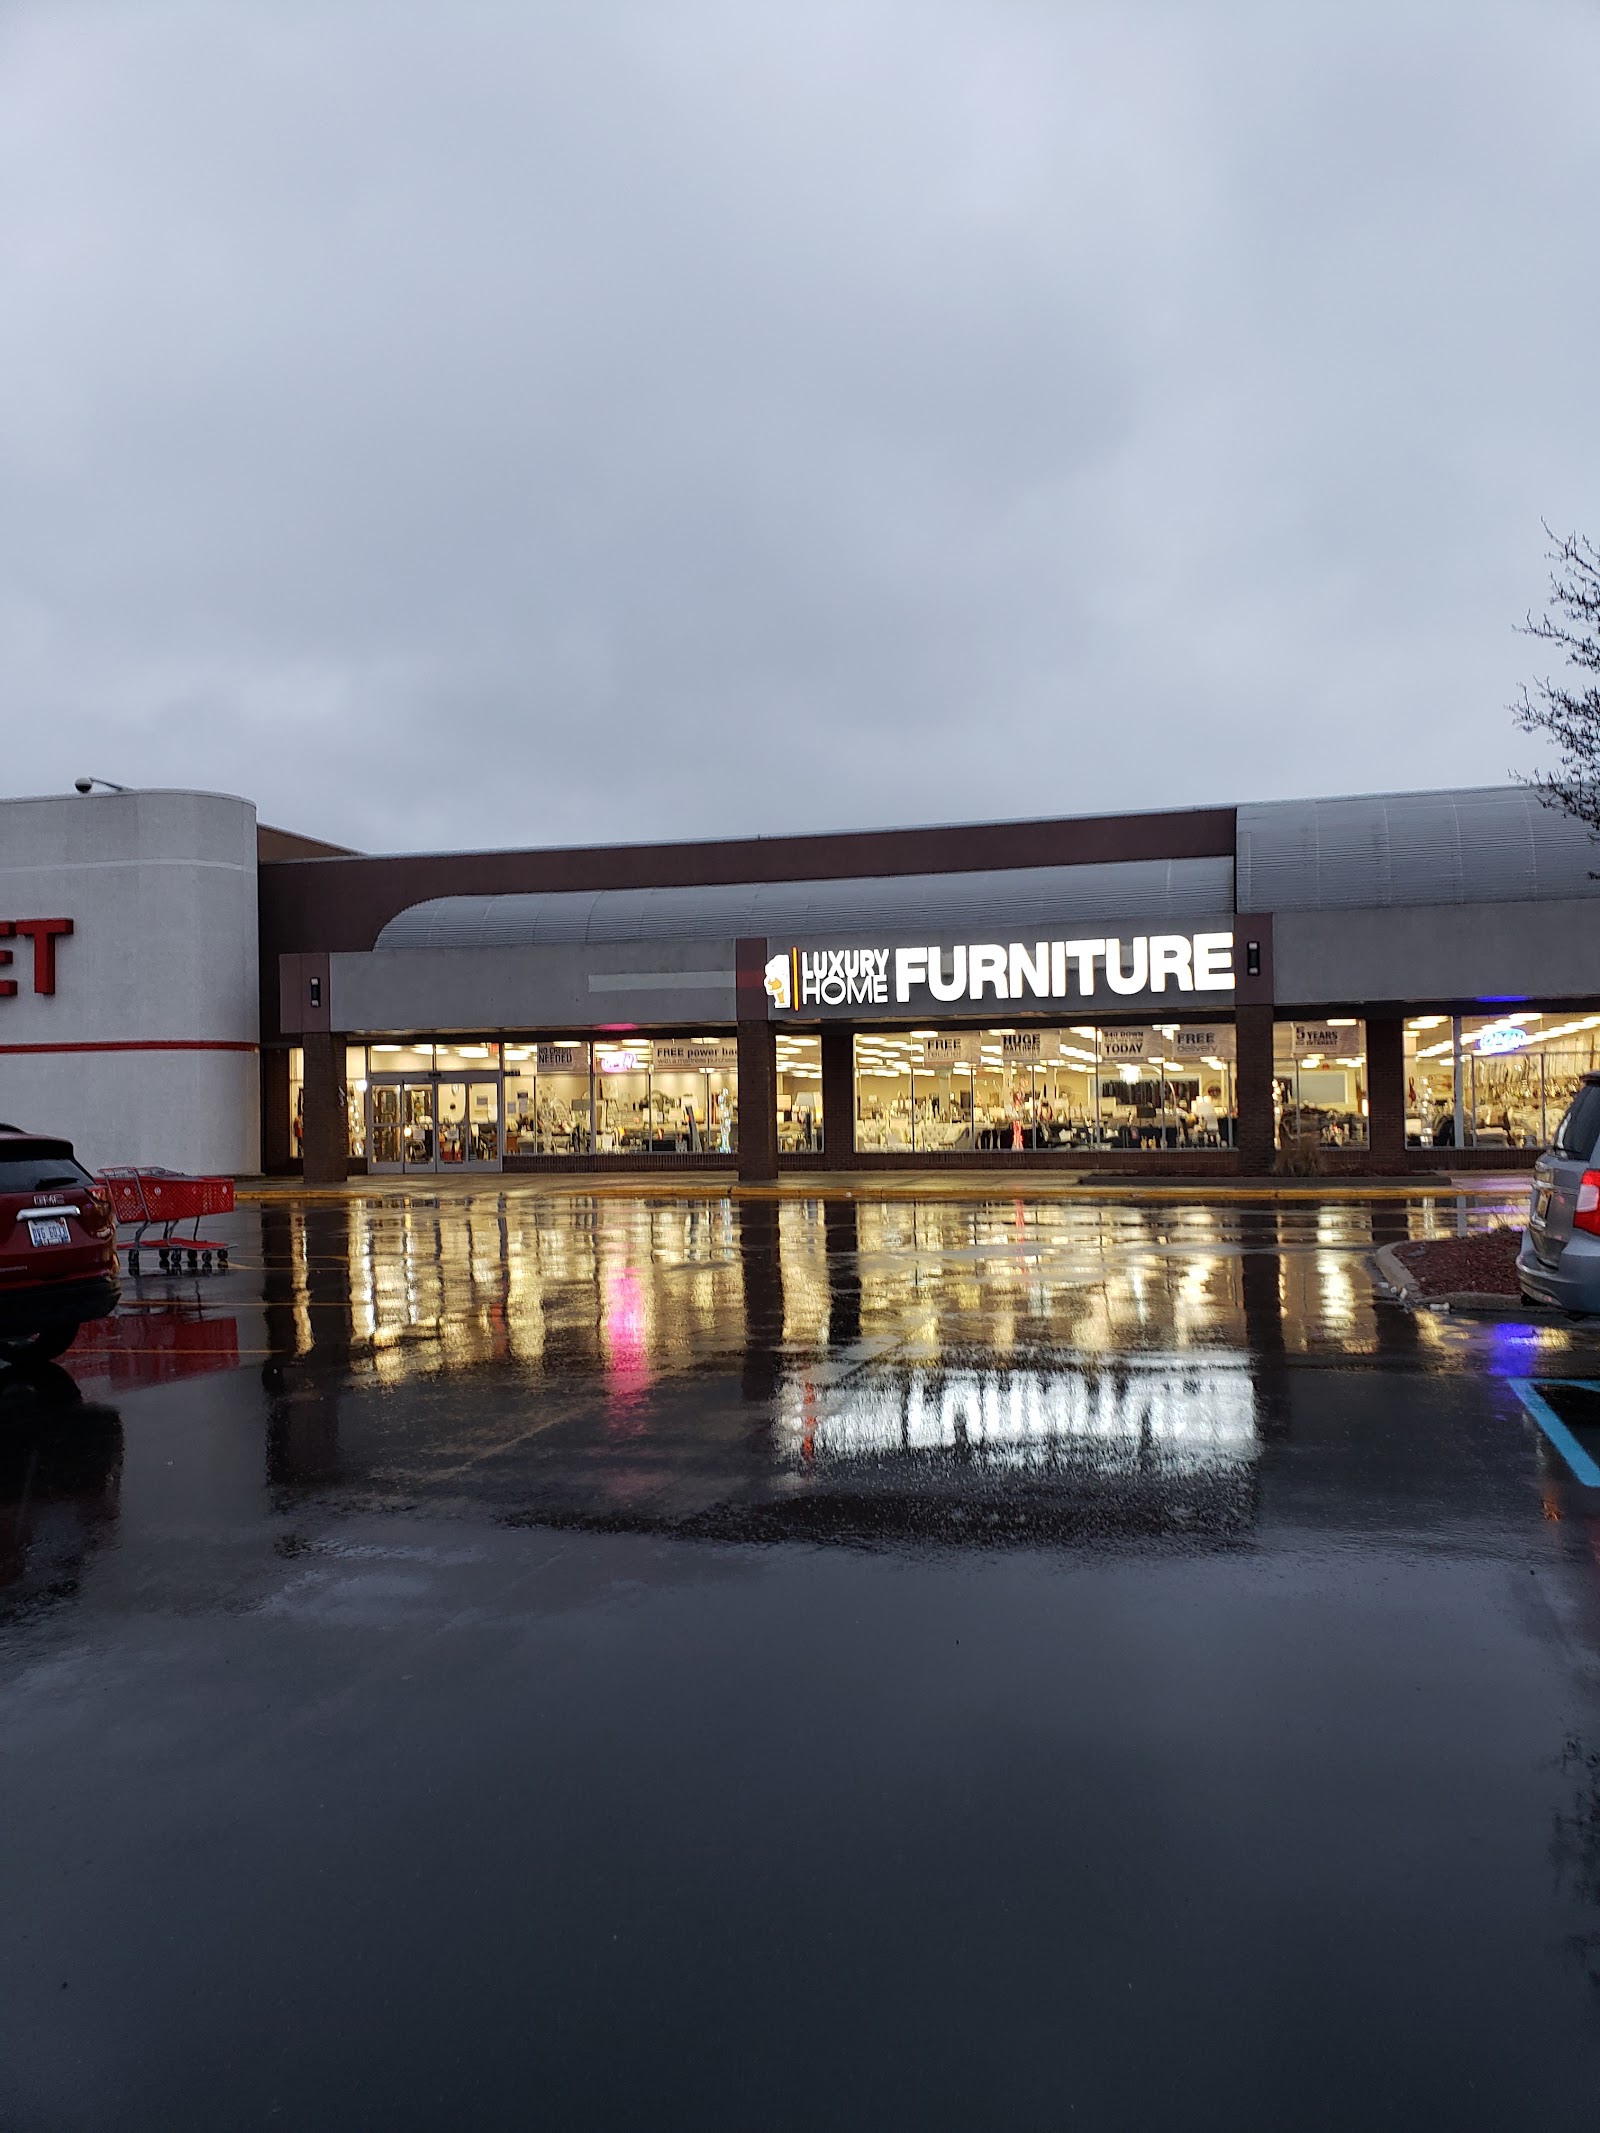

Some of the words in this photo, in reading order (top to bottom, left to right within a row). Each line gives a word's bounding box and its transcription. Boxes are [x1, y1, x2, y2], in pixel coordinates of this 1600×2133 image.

[802, 948, 889, 979] LUXURY
[896, 932, 1235, 1003] FURNITURE
[802, 974, 889, 1005] HOME
[1003, 1033, 1041, 1045] HUGE
[1177, 1033, 1216, 1044] FREE
[1307, 1031, 1338, 1039] YEARS
[927, 1038, 962, 1050] FREE
[1104, 1042, 1143, 1054] TODAY
[1176, 1044, 1218, 1053] delivery
[657, 1047, 684, 1057] FREE
[687, 1047, 719, 1058] power
[538, 1054, 573, 1064] NEEDED
